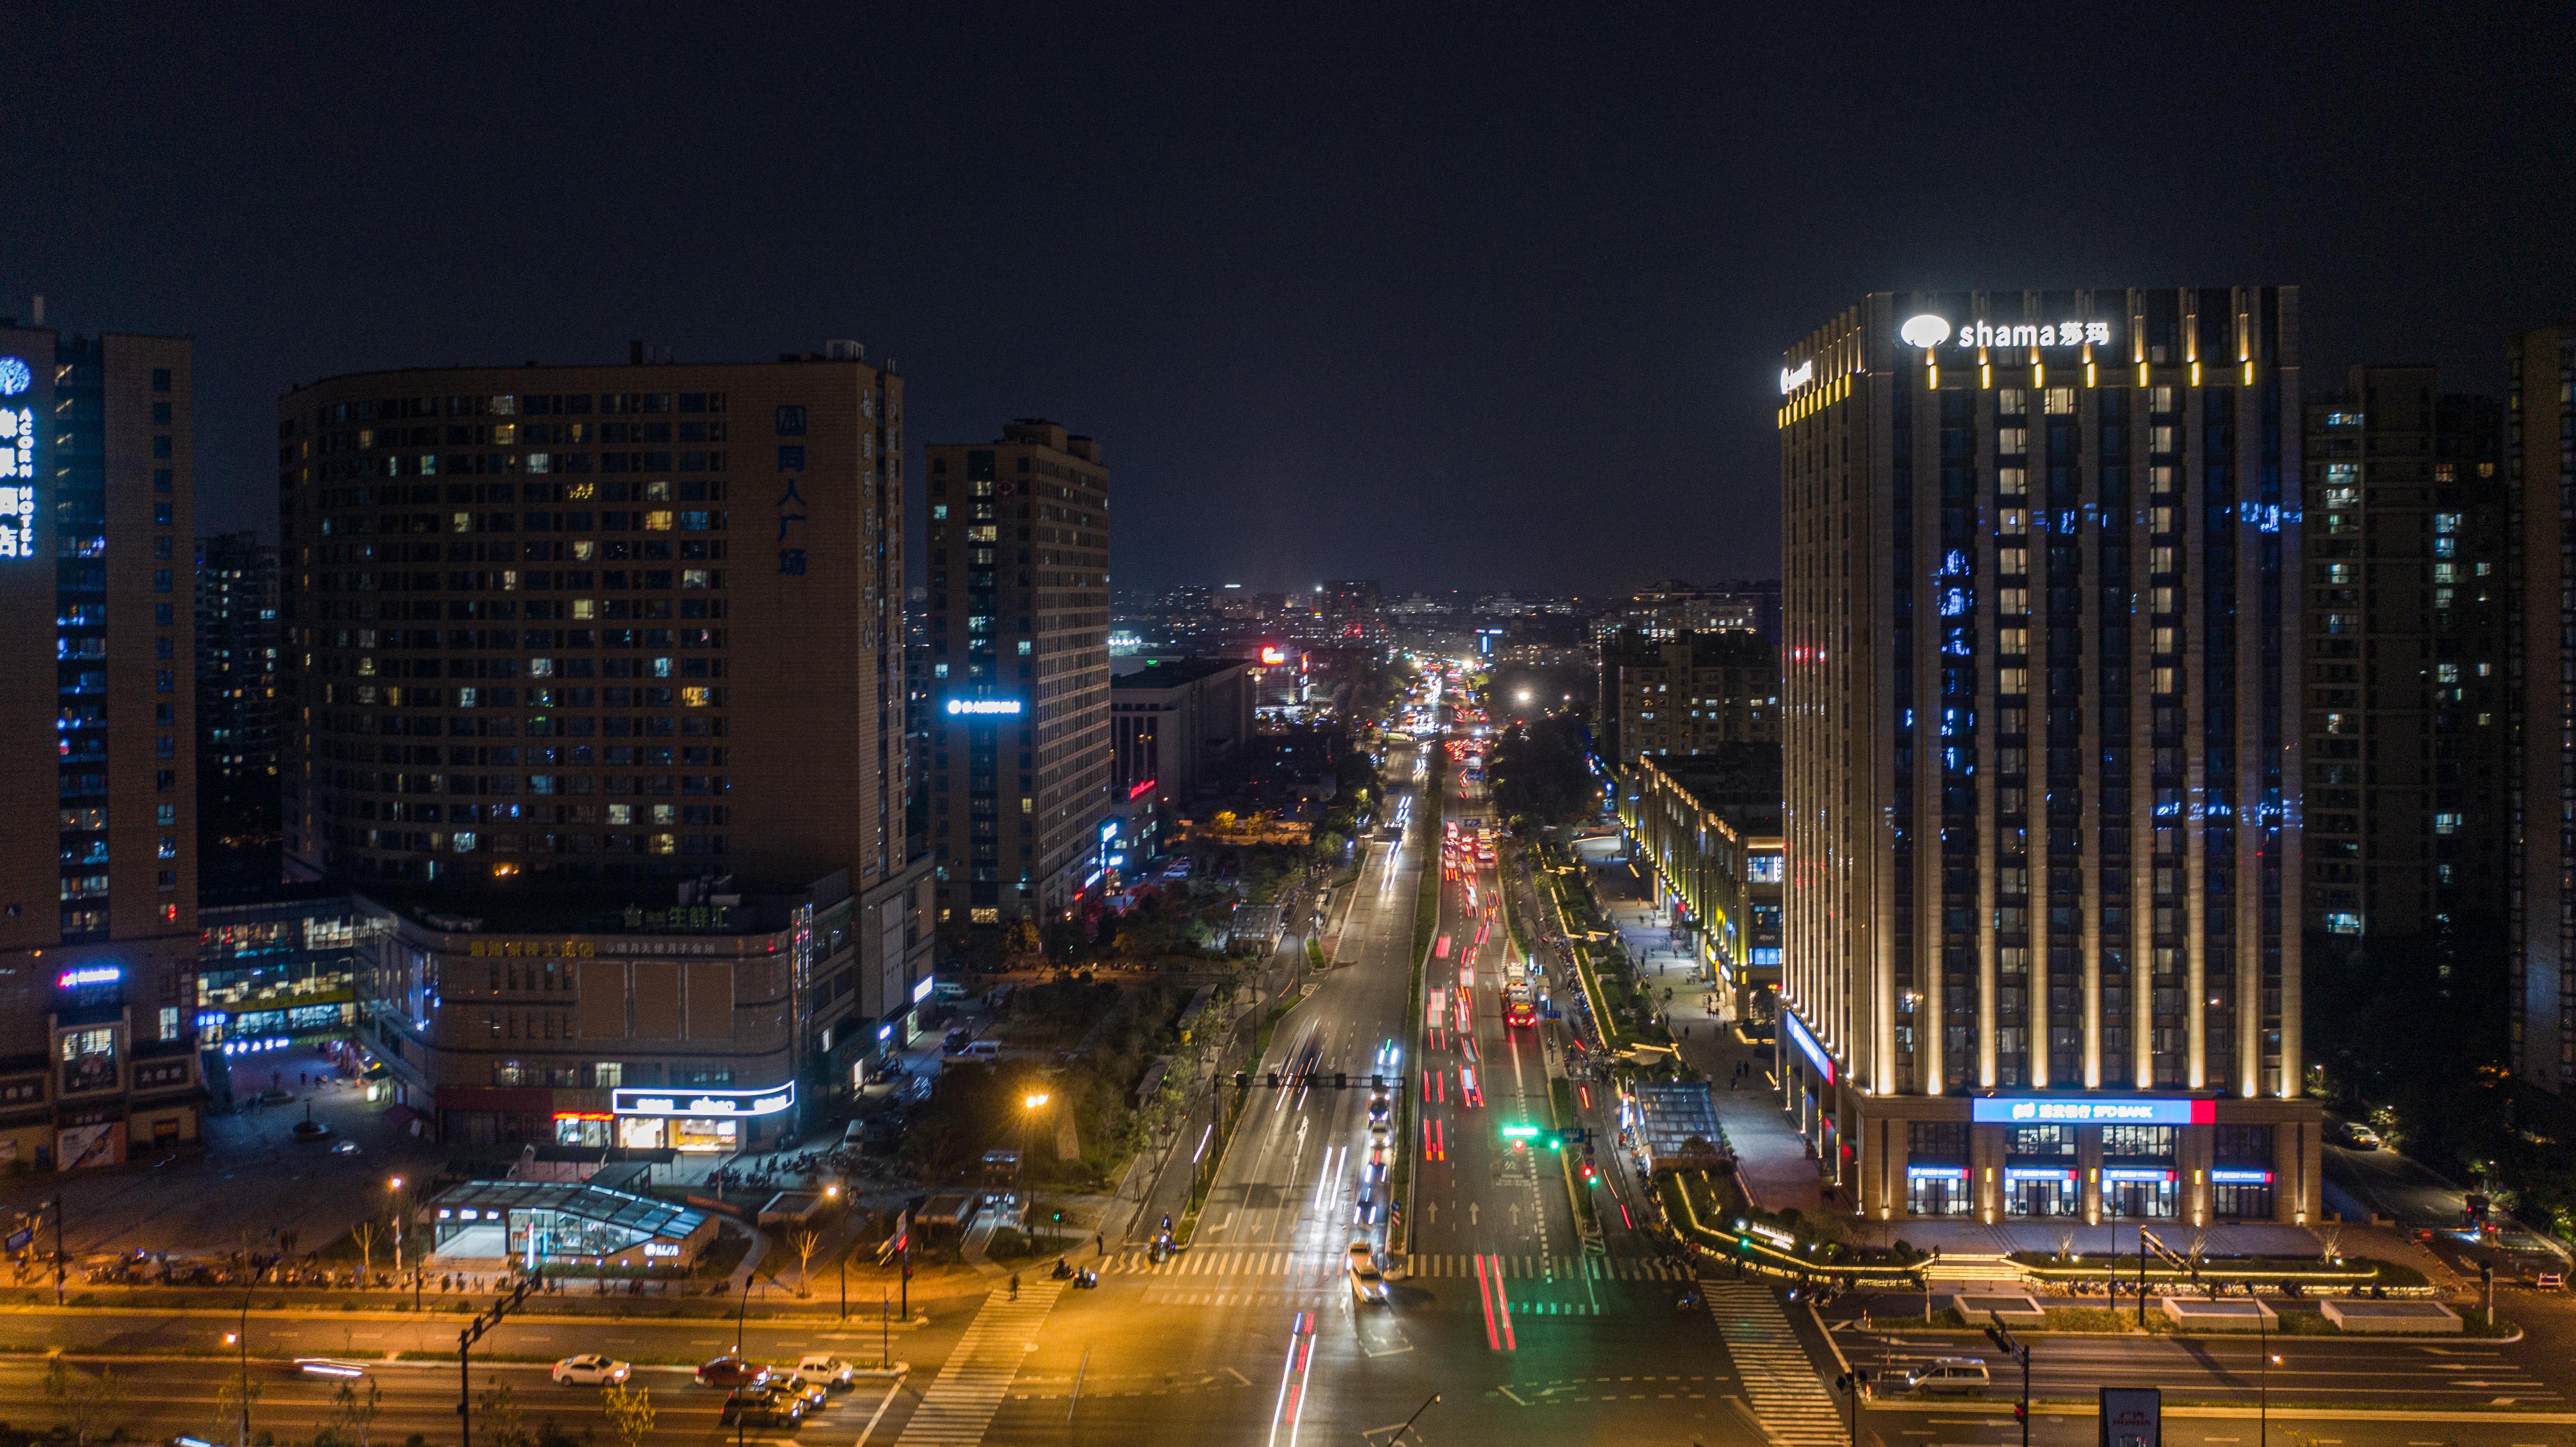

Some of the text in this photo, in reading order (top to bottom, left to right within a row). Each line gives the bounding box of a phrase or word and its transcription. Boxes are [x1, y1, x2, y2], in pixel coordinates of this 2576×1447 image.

[1958, 319, 2055, 347] shama
[18, 407, 34, 557] ACORN HOTEL
[777, 445, 806, 577] 同人广场
